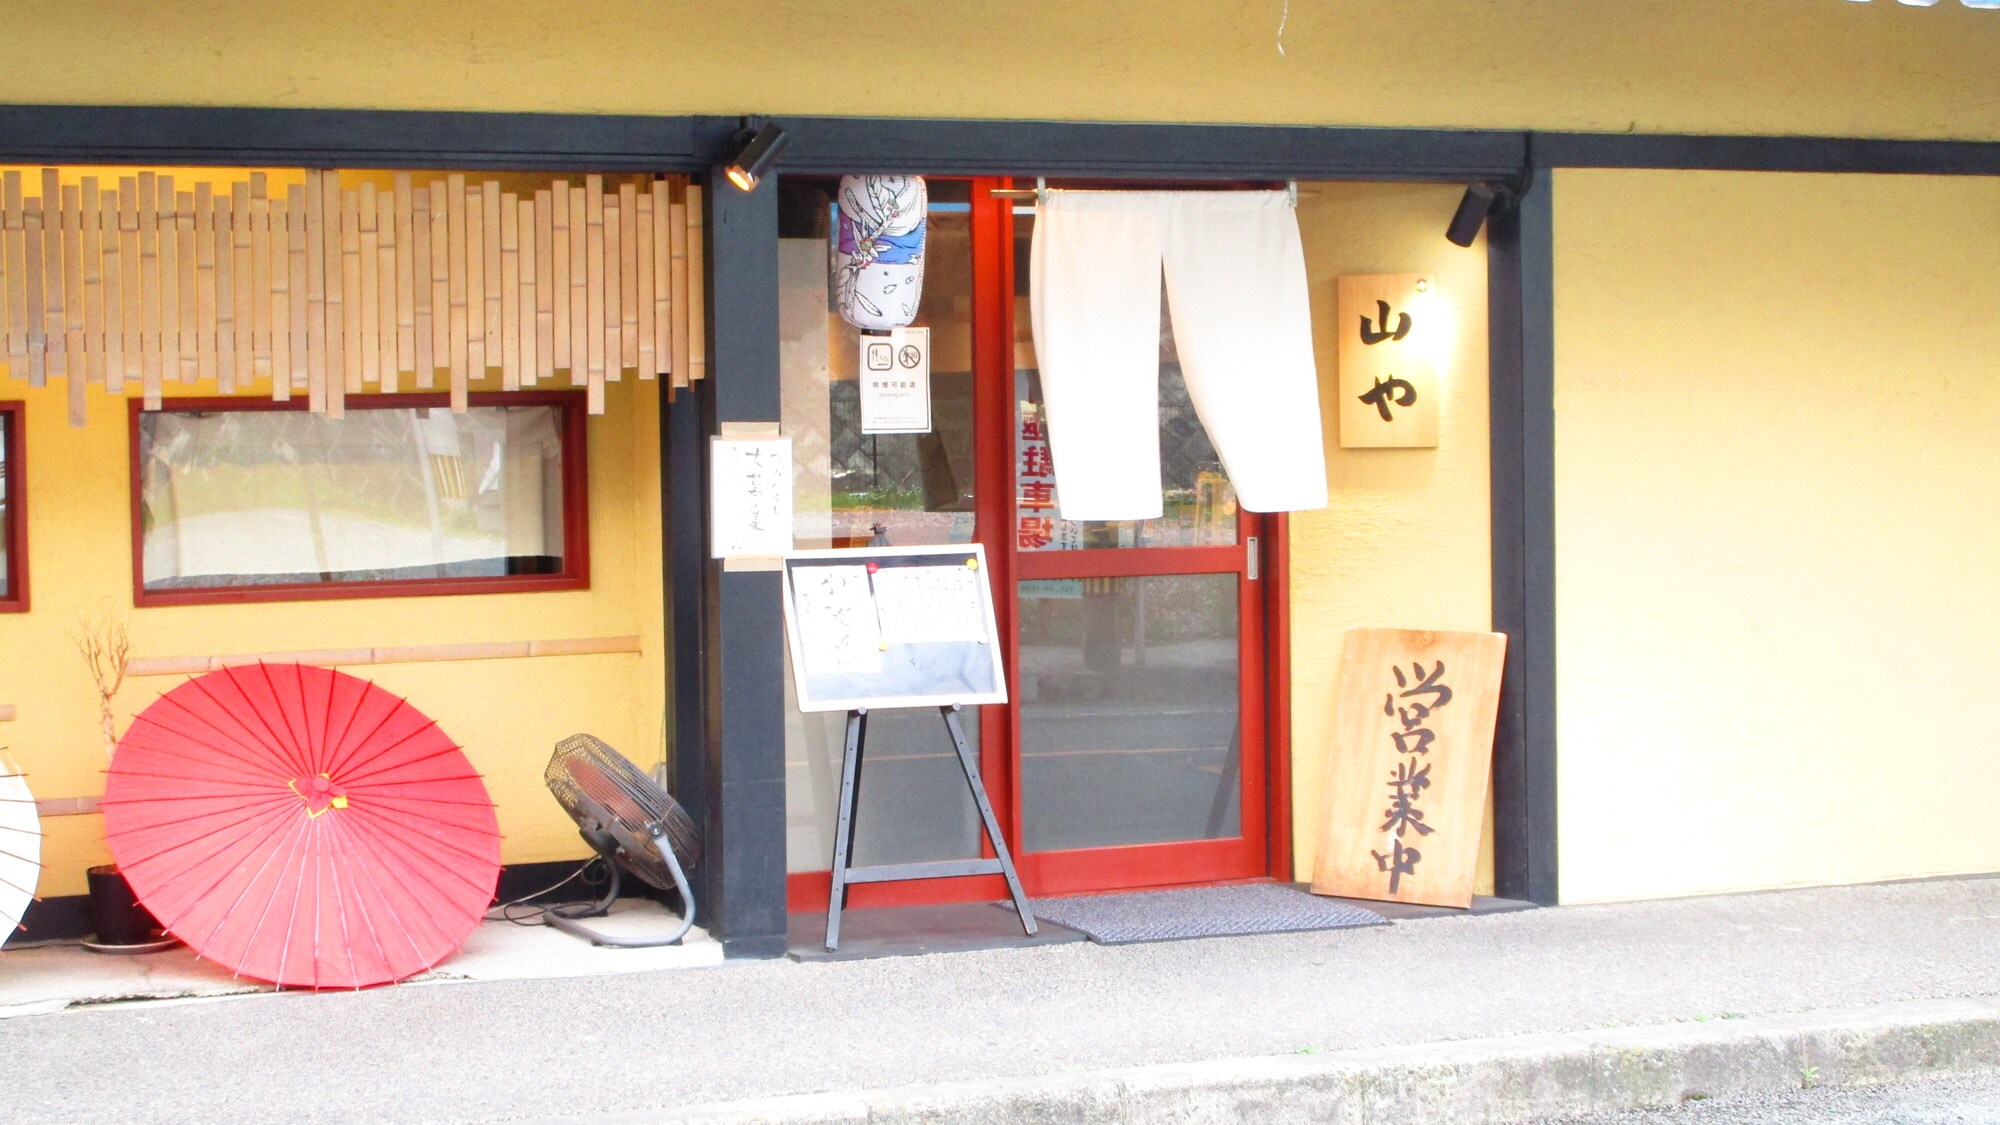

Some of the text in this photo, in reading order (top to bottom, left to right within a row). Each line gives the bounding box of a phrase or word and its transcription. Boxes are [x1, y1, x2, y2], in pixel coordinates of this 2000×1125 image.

[1359, 299, 1418, 422] 山や
[1371, 660, 1454, 894] 営業中
